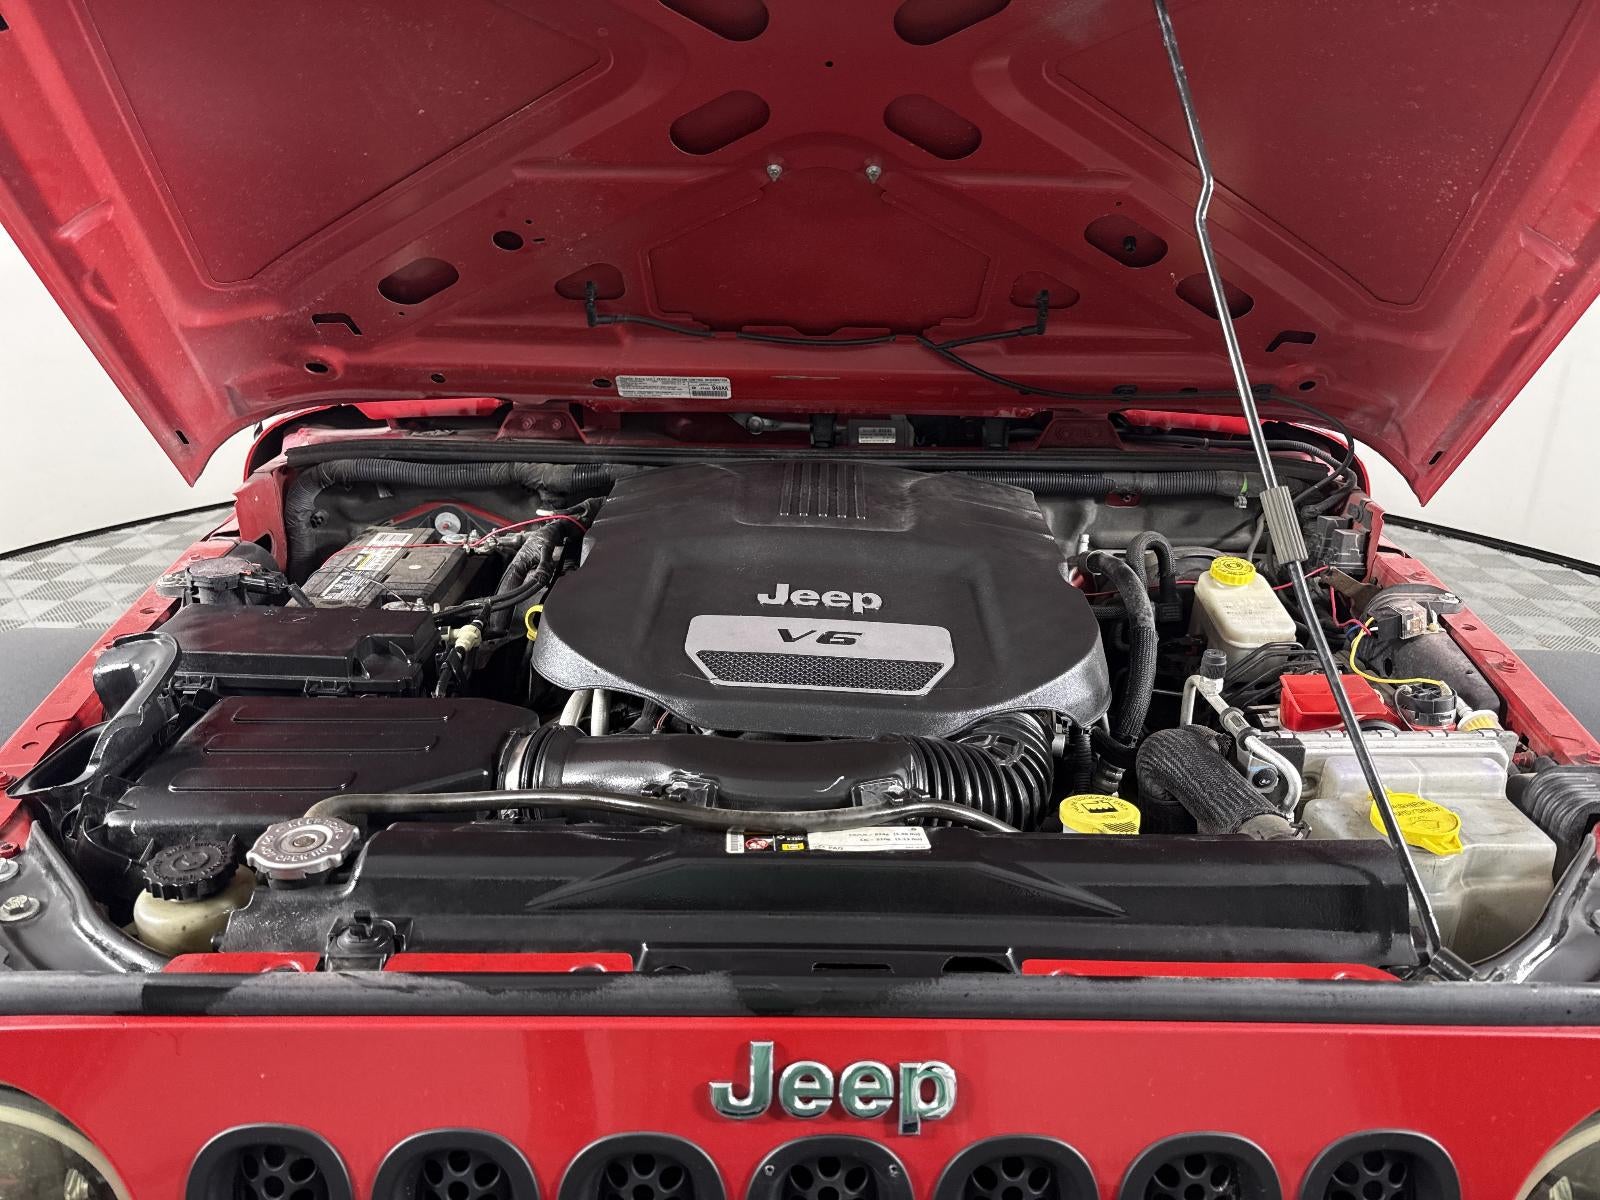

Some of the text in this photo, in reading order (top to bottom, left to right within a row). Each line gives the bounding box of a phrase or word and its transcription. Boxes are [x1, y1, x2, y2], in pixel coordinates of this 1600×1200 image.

[757, 583, 883, 614] Jeep
[777, 628, 862, 646] V6
[709, 1041, 957, 1136] Jeep
